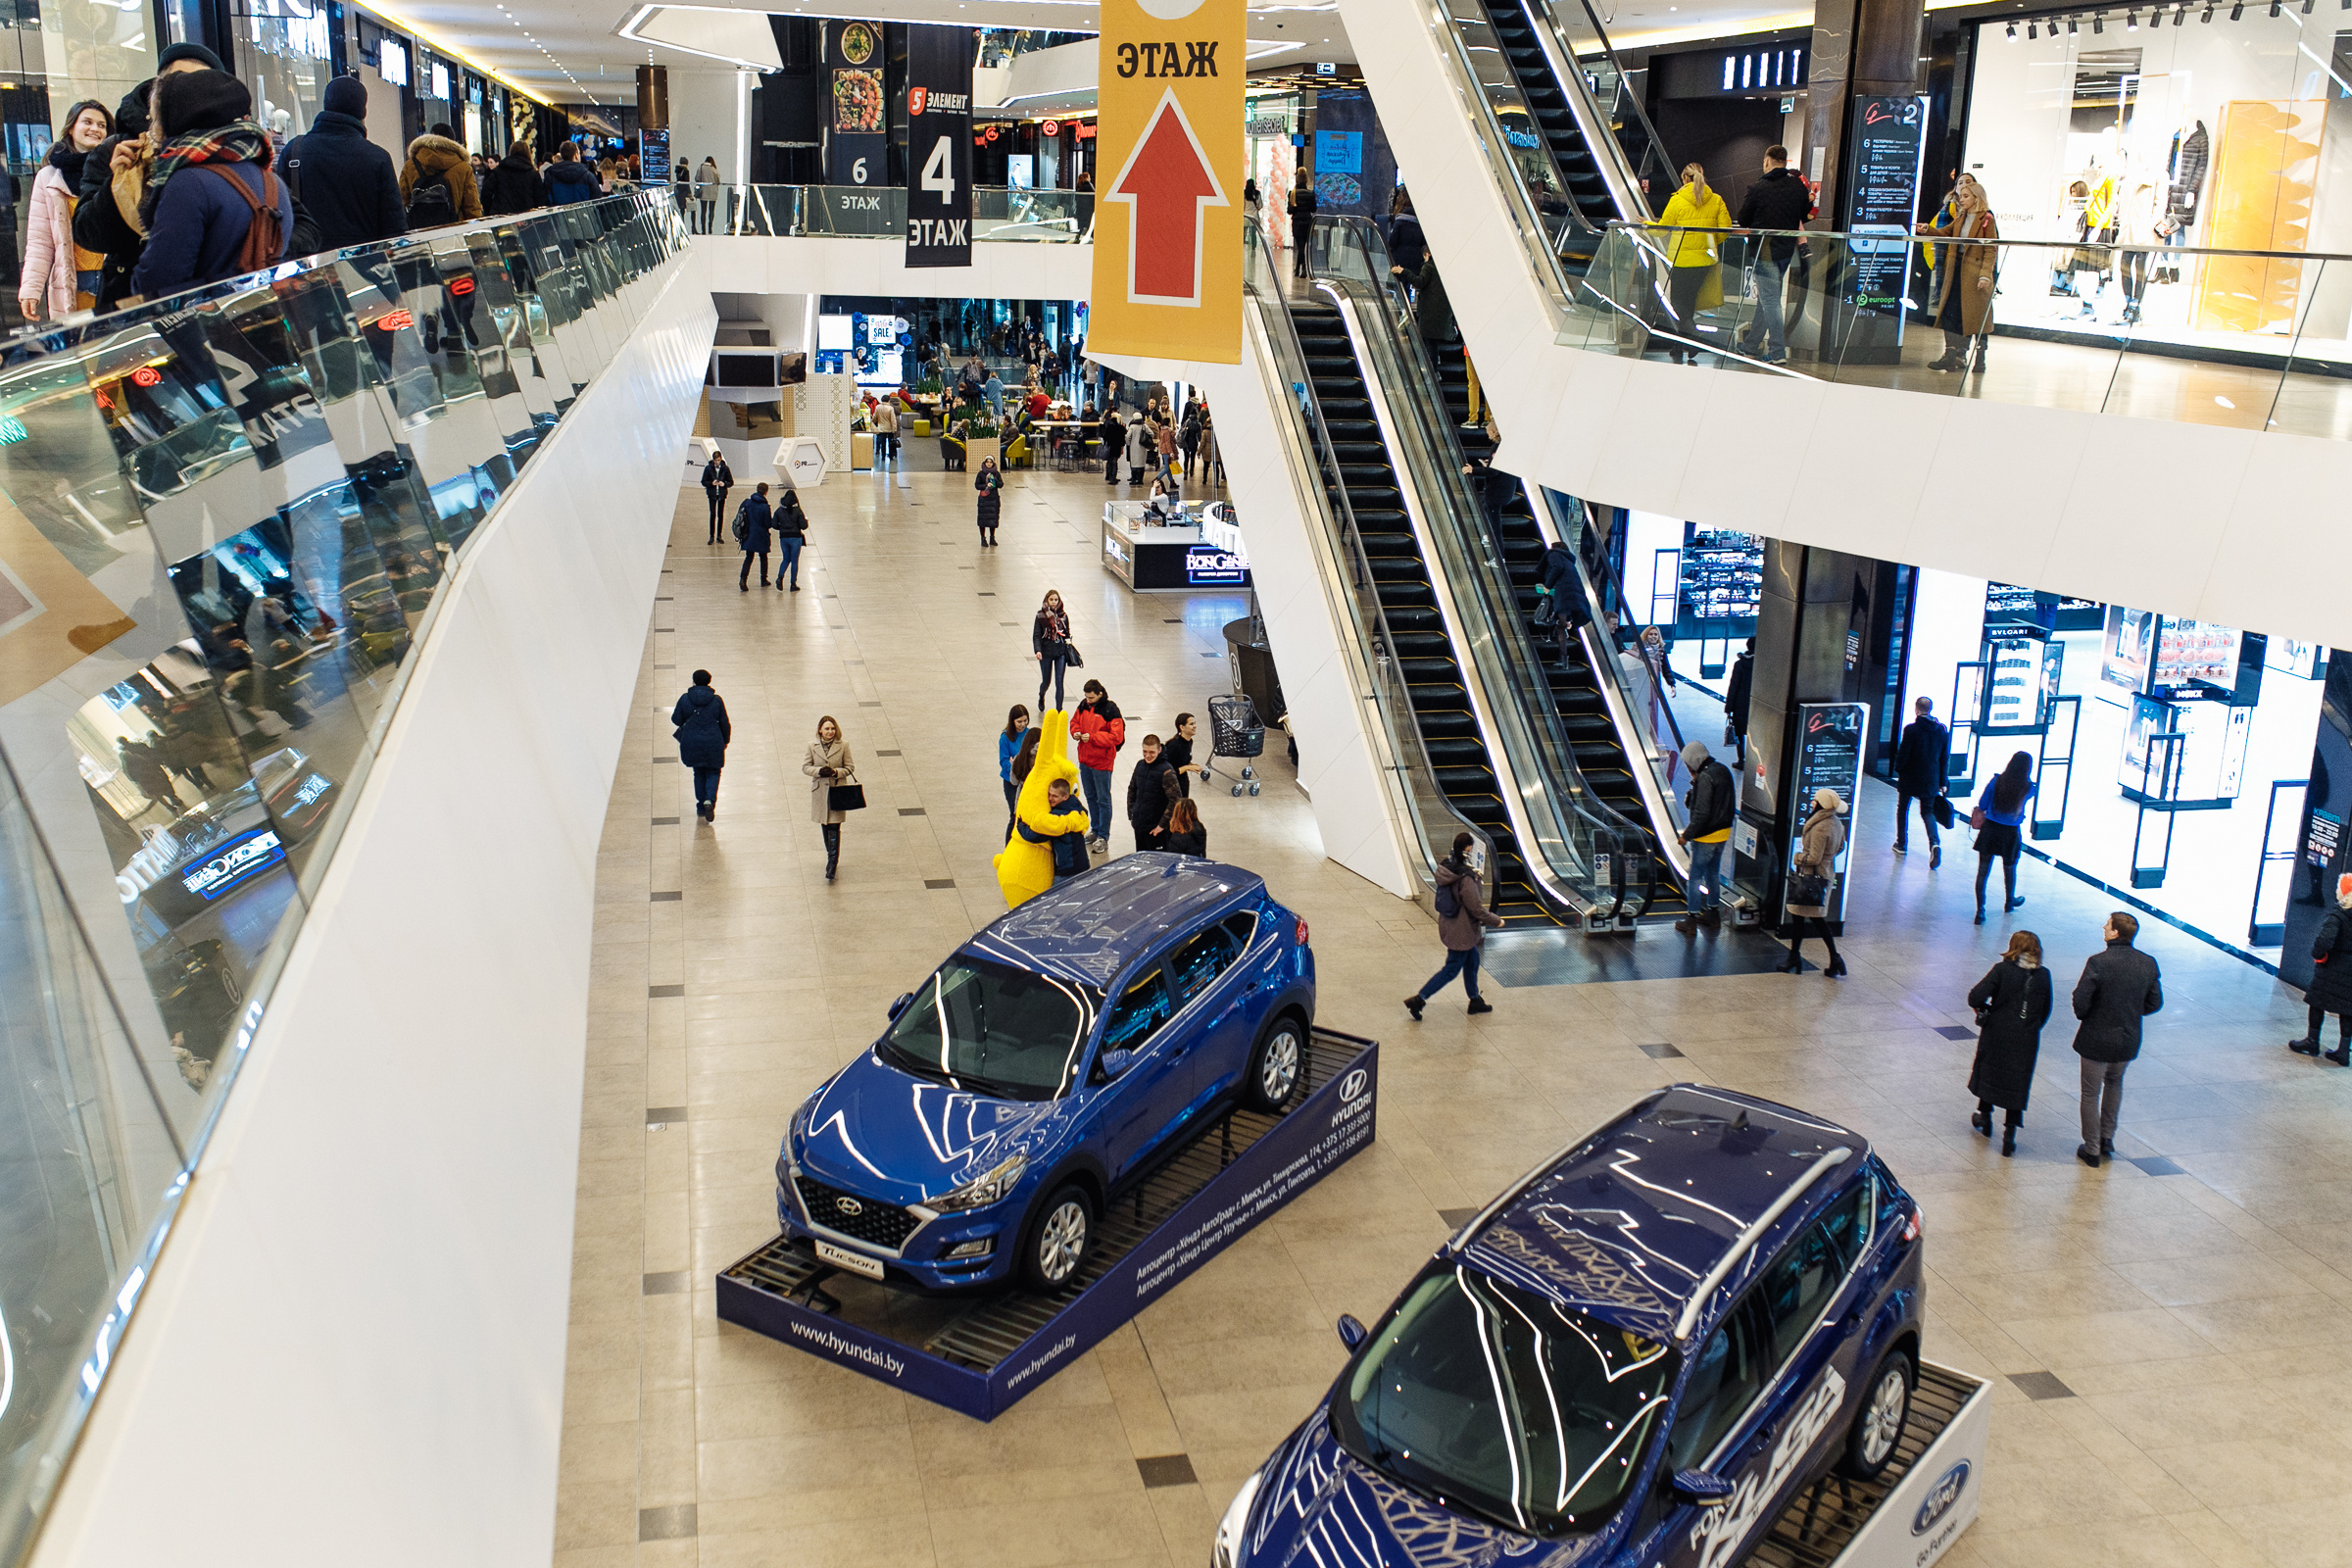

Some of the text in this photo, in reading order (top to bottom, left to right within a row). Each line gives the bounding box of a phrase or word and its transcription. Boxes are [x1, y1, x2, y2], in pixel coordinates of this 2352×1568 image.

[1117, 41, 1218, 78] ЭТАЖ
[911, 91, 968, 111] 5 ЭЛЕМЕНТ
[1902, 104, 1918, 124] 2
[1863, 139, 1871, 148] 6
[852, 157, 868, 184] 6
[921, 135, 956, 205] 4
[1861, 164, 1868, 174] 5
[1858, 187, 1865, 196] 4
[841, 196, 881, 210] ЭТАЖ
[1856, 206, 1863, 217] 3
[908, 219, 968, 246] ЭТАЖ
[1850, 256, 1858, 266] 1
[874, 327, 890, 338] SALE
[1844, 712, 1859, 730] 1
[1806, 744, 1814, 753] 6
[1802, 786, 1810, 794] 4
[1800, 803, 1807, 811] 3
[1799, 817, 1806, 826] 2
[1332, 1091, 1372, 1127] HYUNDAI
[1137, 1247, 1176, 1281] Автоцентр
[1201, 1205, 1235, 1234] АвтоГрад»
[1322, 1133, 1338, 1149] +375
[1137, 1264, 1176, 1298] Автоцентр
[1201, 1229, 1223, 1251] Центр
[1323, 1148, 1338, 1165] +375
[822, 1245, 876, 1271] TUCSON
[791, 1321, 905, 1377] www.hyundai.by
[1007, 1333, 1076, 1390] www.hyundai.by
[1920, 1469, 1961, 1529] Ford
[1917, 1518, 1958, 1568] Go Further
